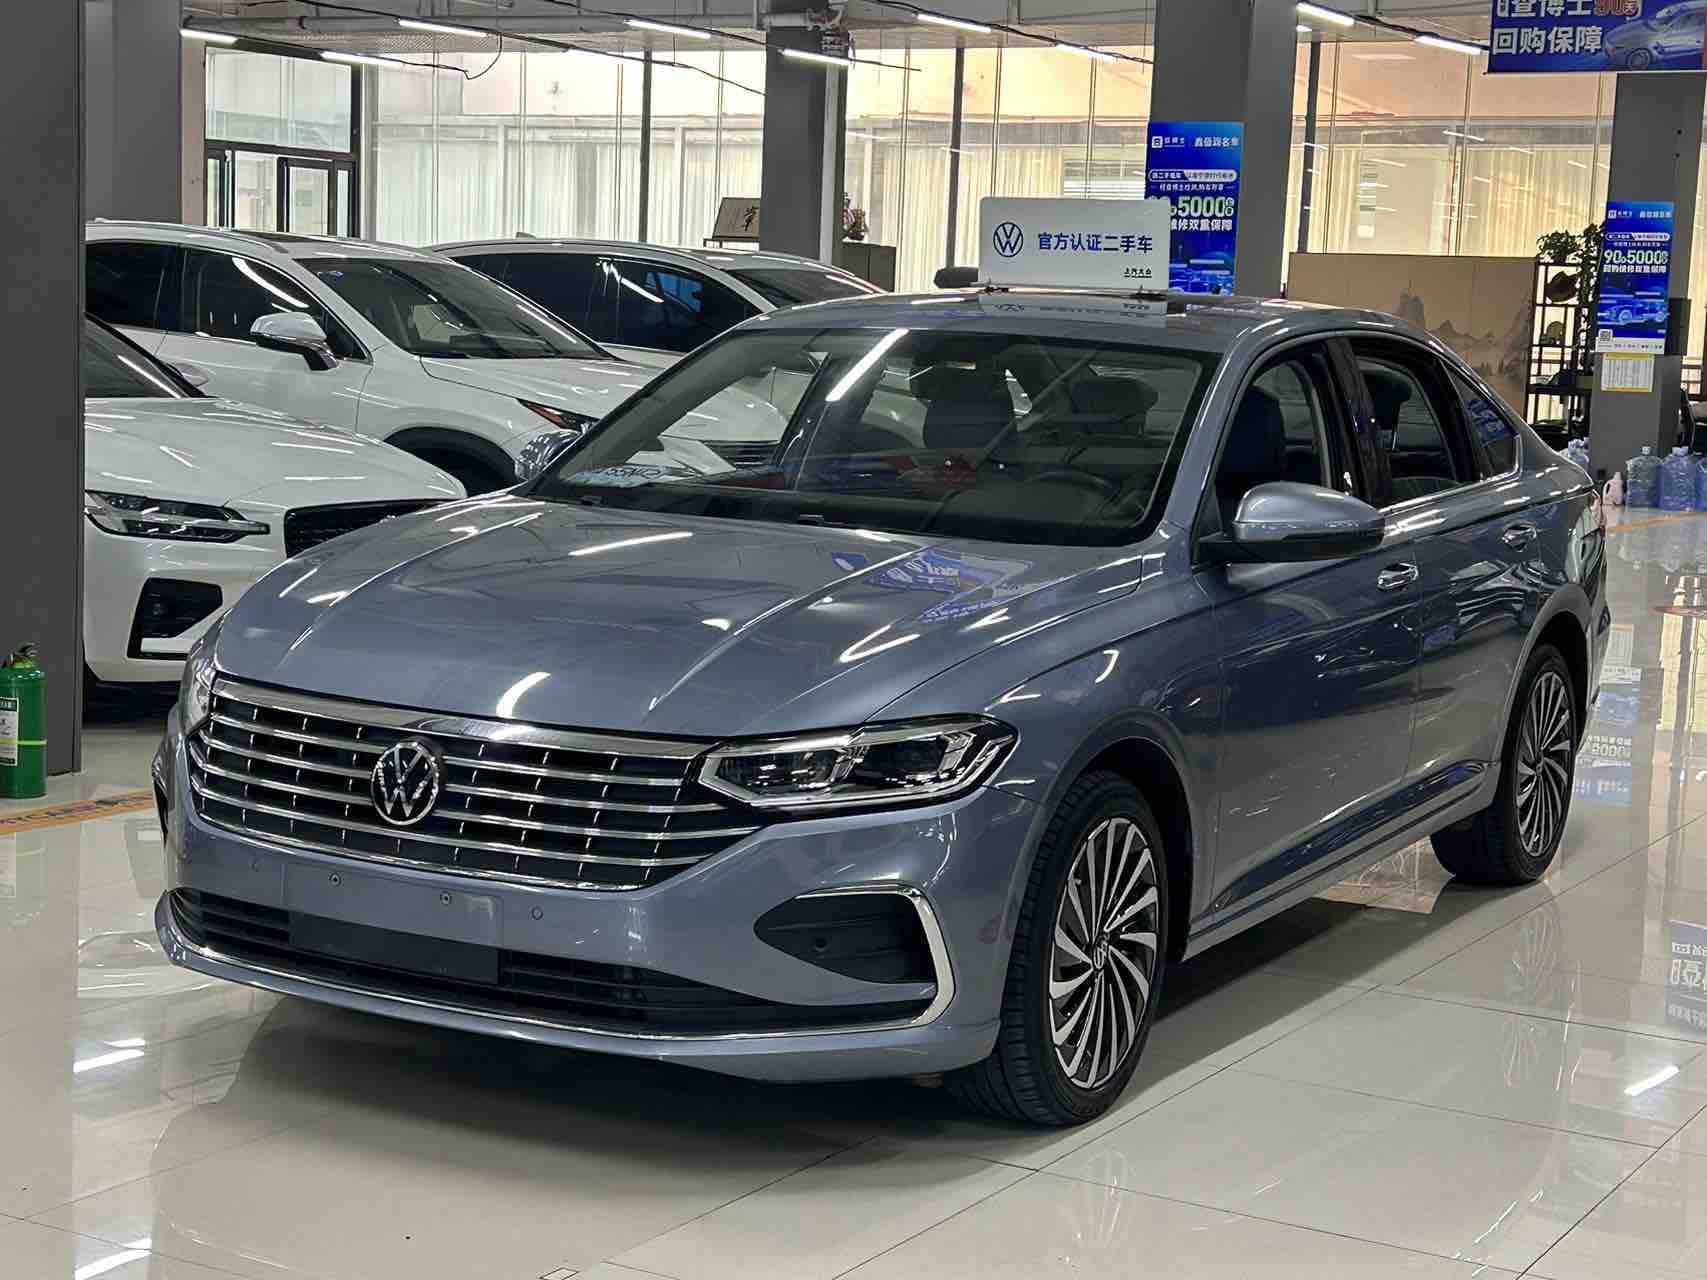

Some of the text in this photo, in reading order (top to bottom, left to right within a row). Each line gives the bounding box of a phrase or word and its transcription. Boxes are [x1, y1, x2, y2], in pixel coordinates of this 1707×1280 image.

[1491, 26, 1602, 54] 回购保障
[1038, 232, 1153, 254] 官方认证二手车
[371, 743, 440, 825] VW
